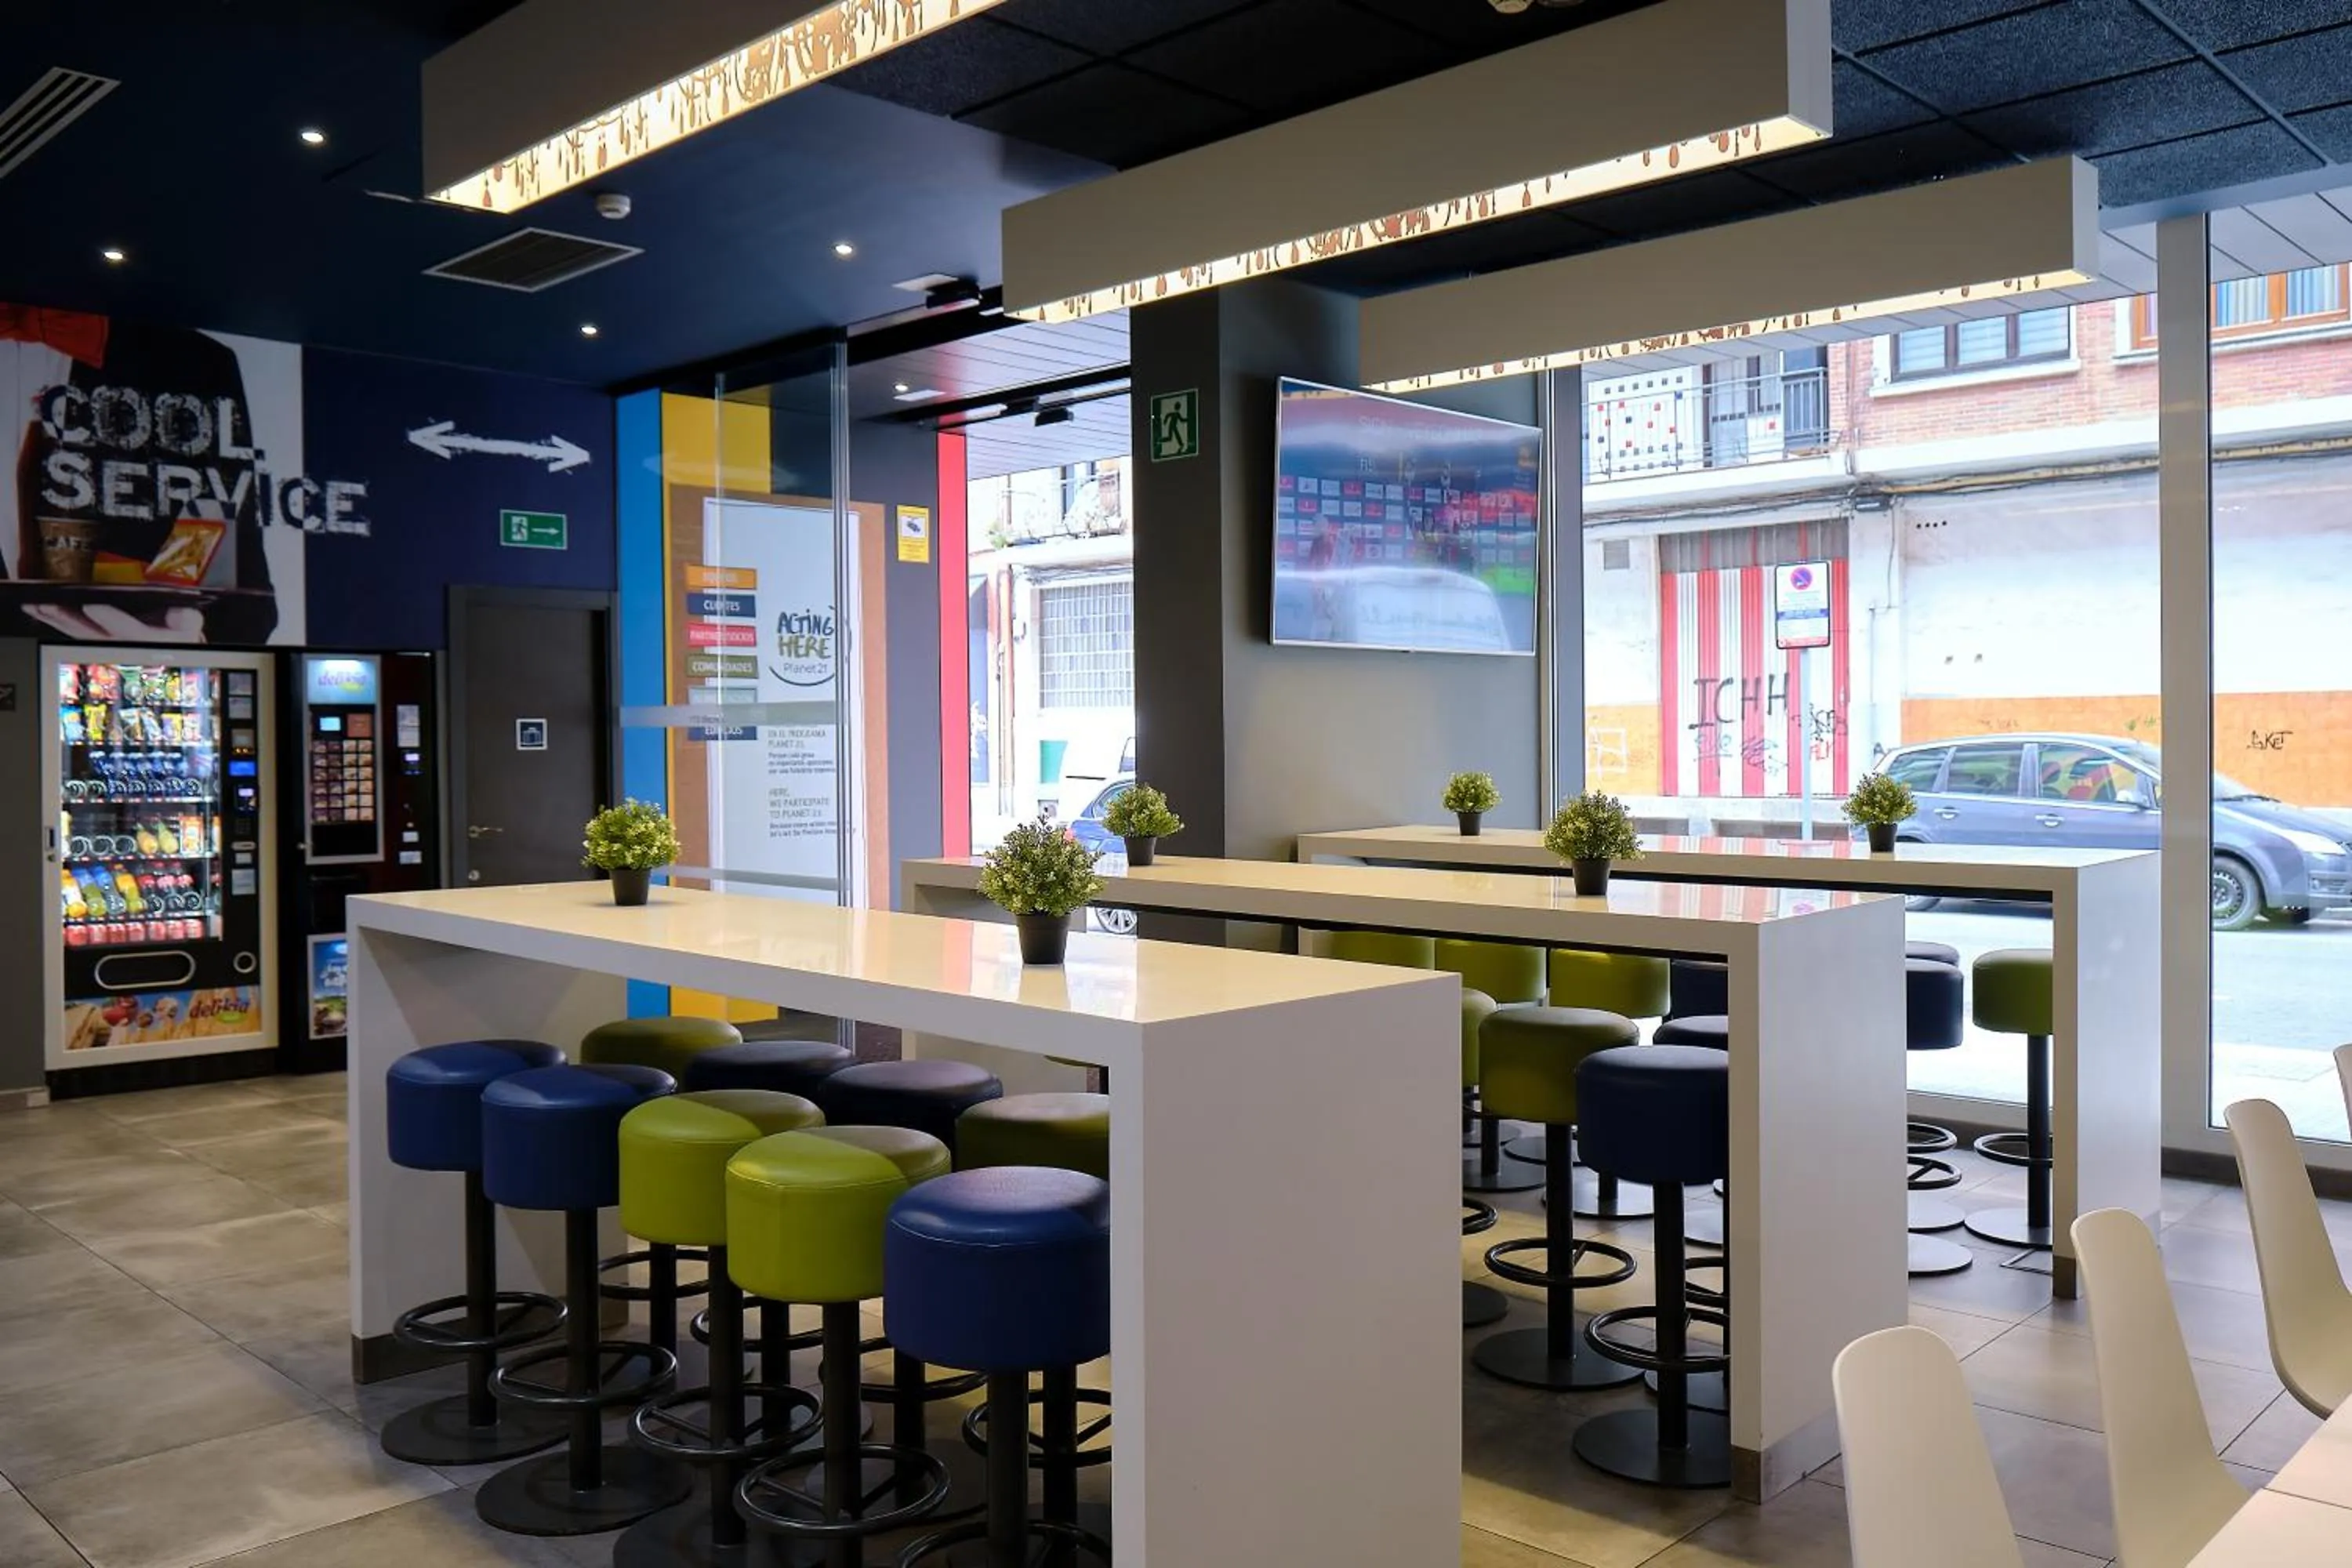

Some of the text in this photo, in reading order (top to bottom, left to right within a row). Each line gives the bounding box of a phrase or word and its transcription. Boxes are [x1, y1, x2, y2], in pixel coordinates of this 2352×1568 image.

[41, 449, 372, 538] SERVICE
[777, 608, 834, 636] ACTING
[778, 634, 832, 659] HERE
